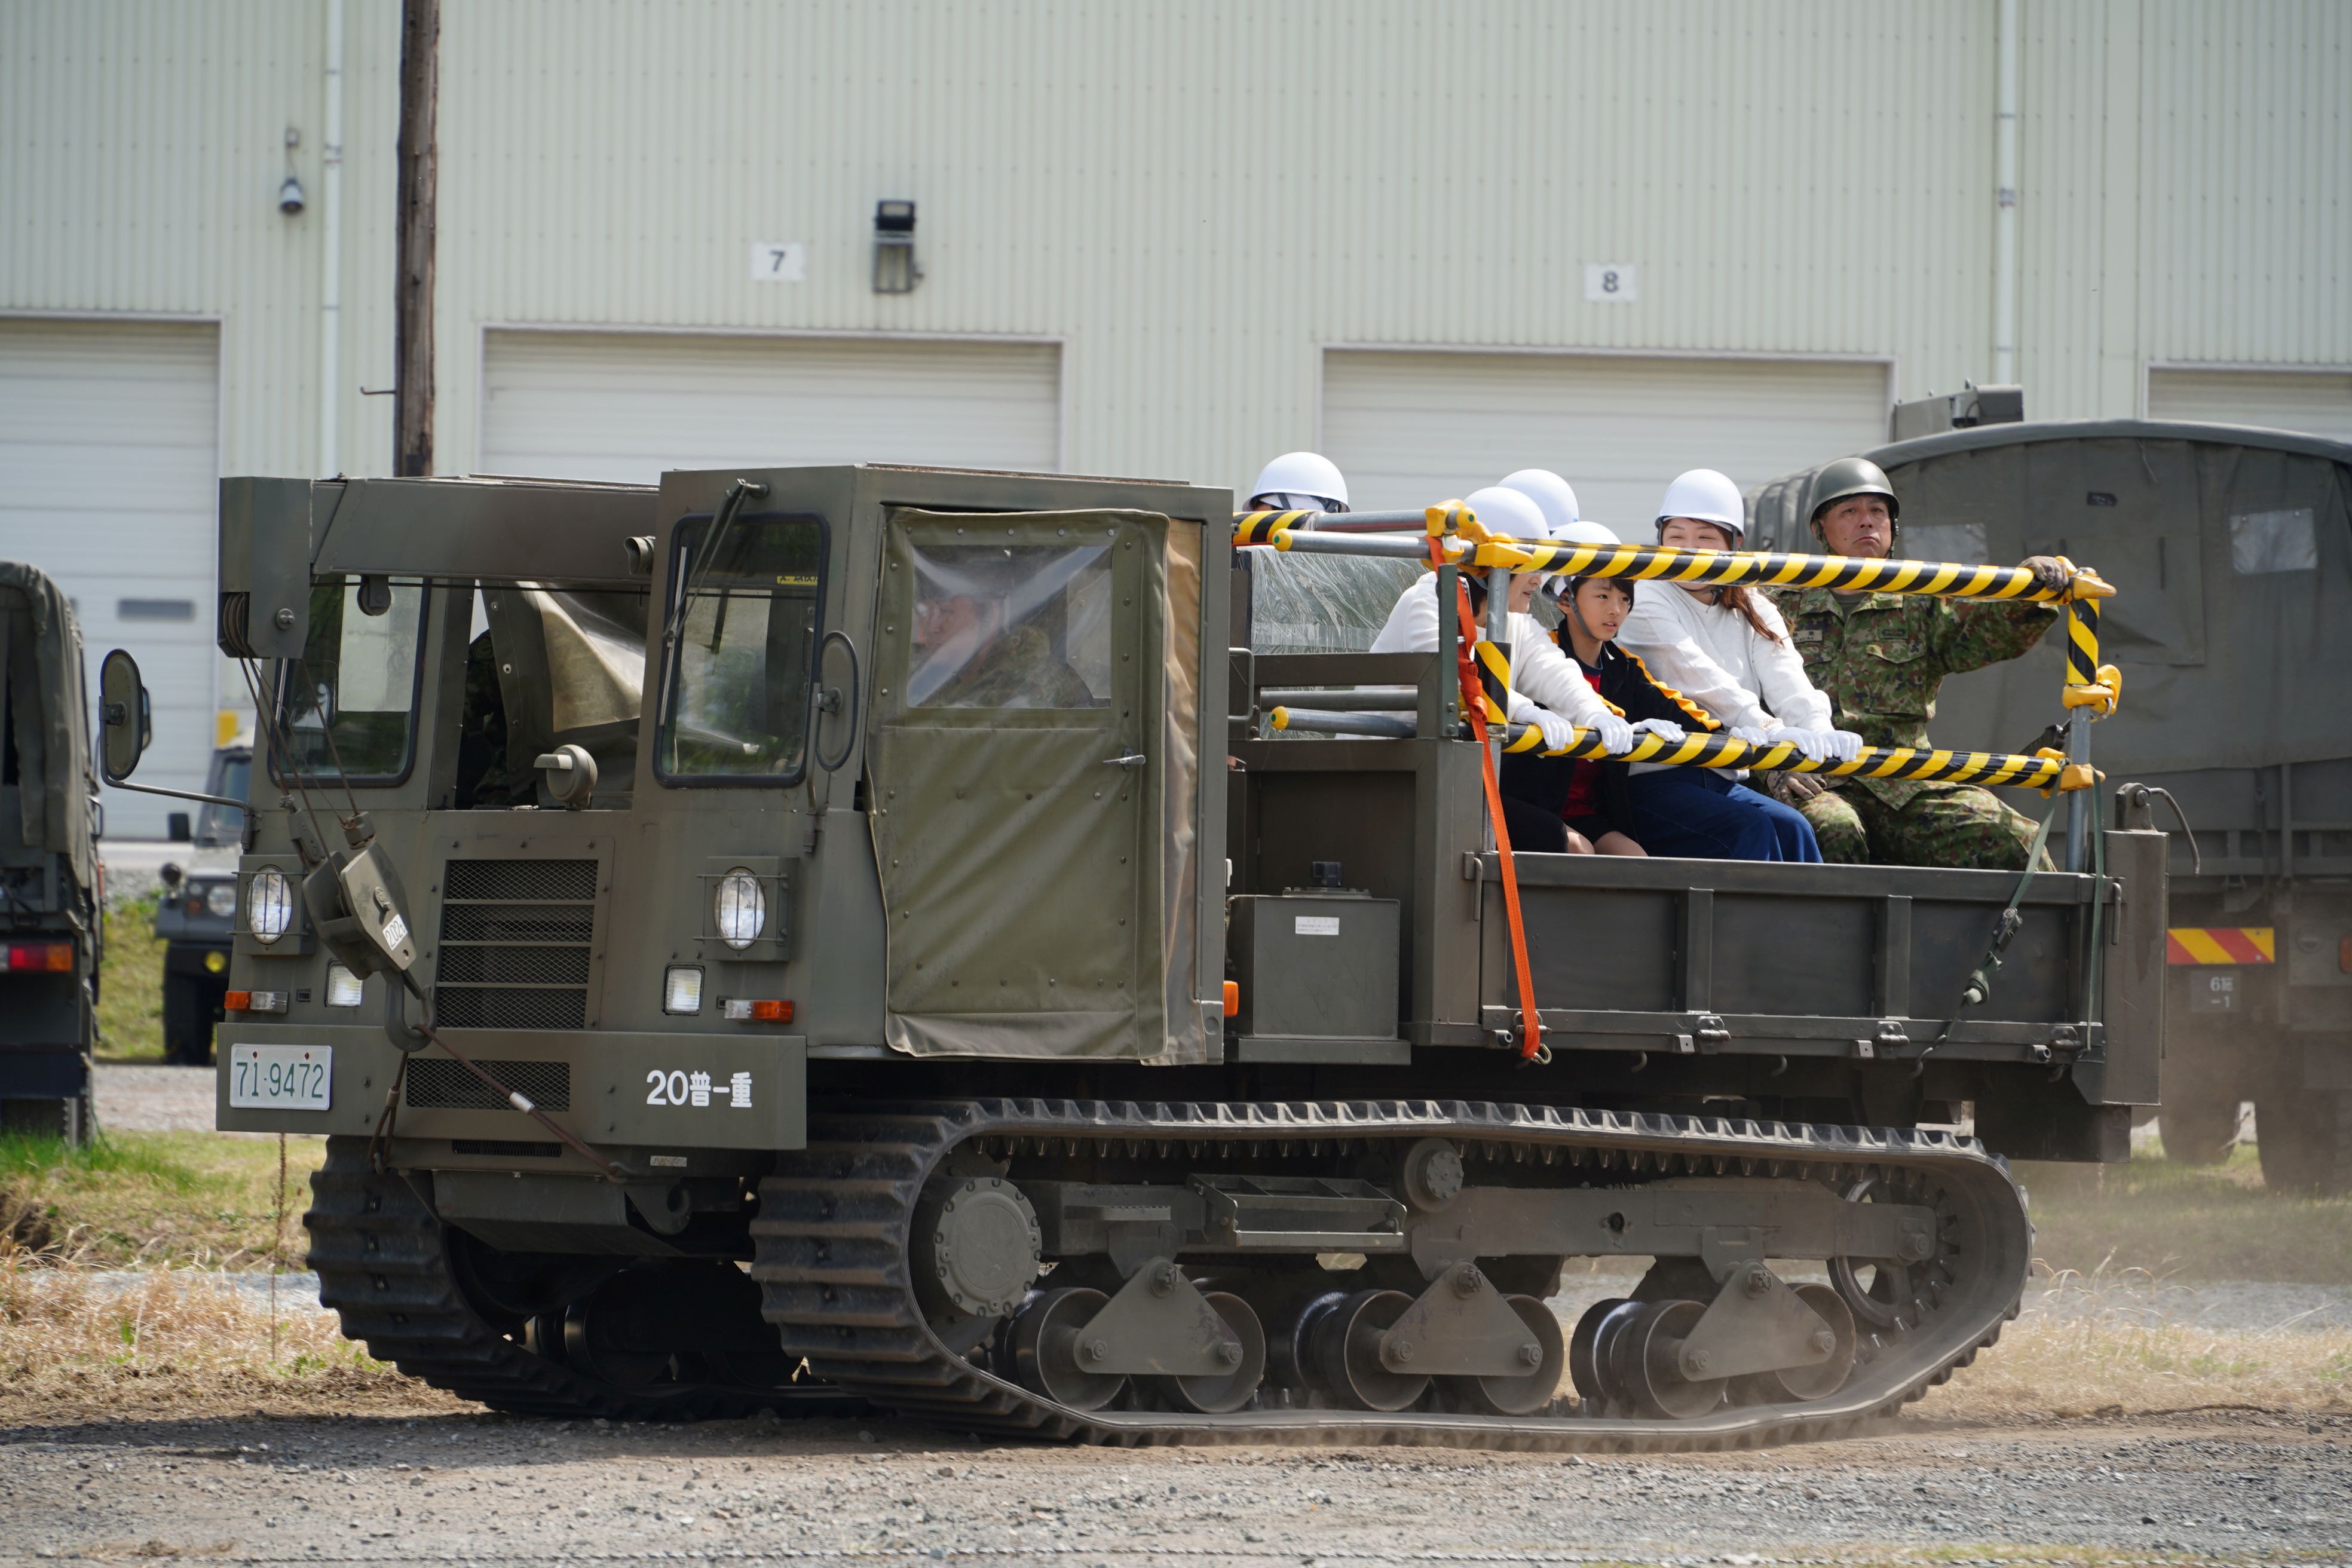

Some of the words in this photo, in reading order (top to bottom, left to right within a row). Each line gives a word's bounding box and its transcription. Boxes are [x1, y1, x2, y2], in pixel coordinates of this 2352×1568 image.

[768, 249, 786, 273] 7
[1603, 271, 1619, 293] 8
[236, 1062, 324, 1098] 71-9472
